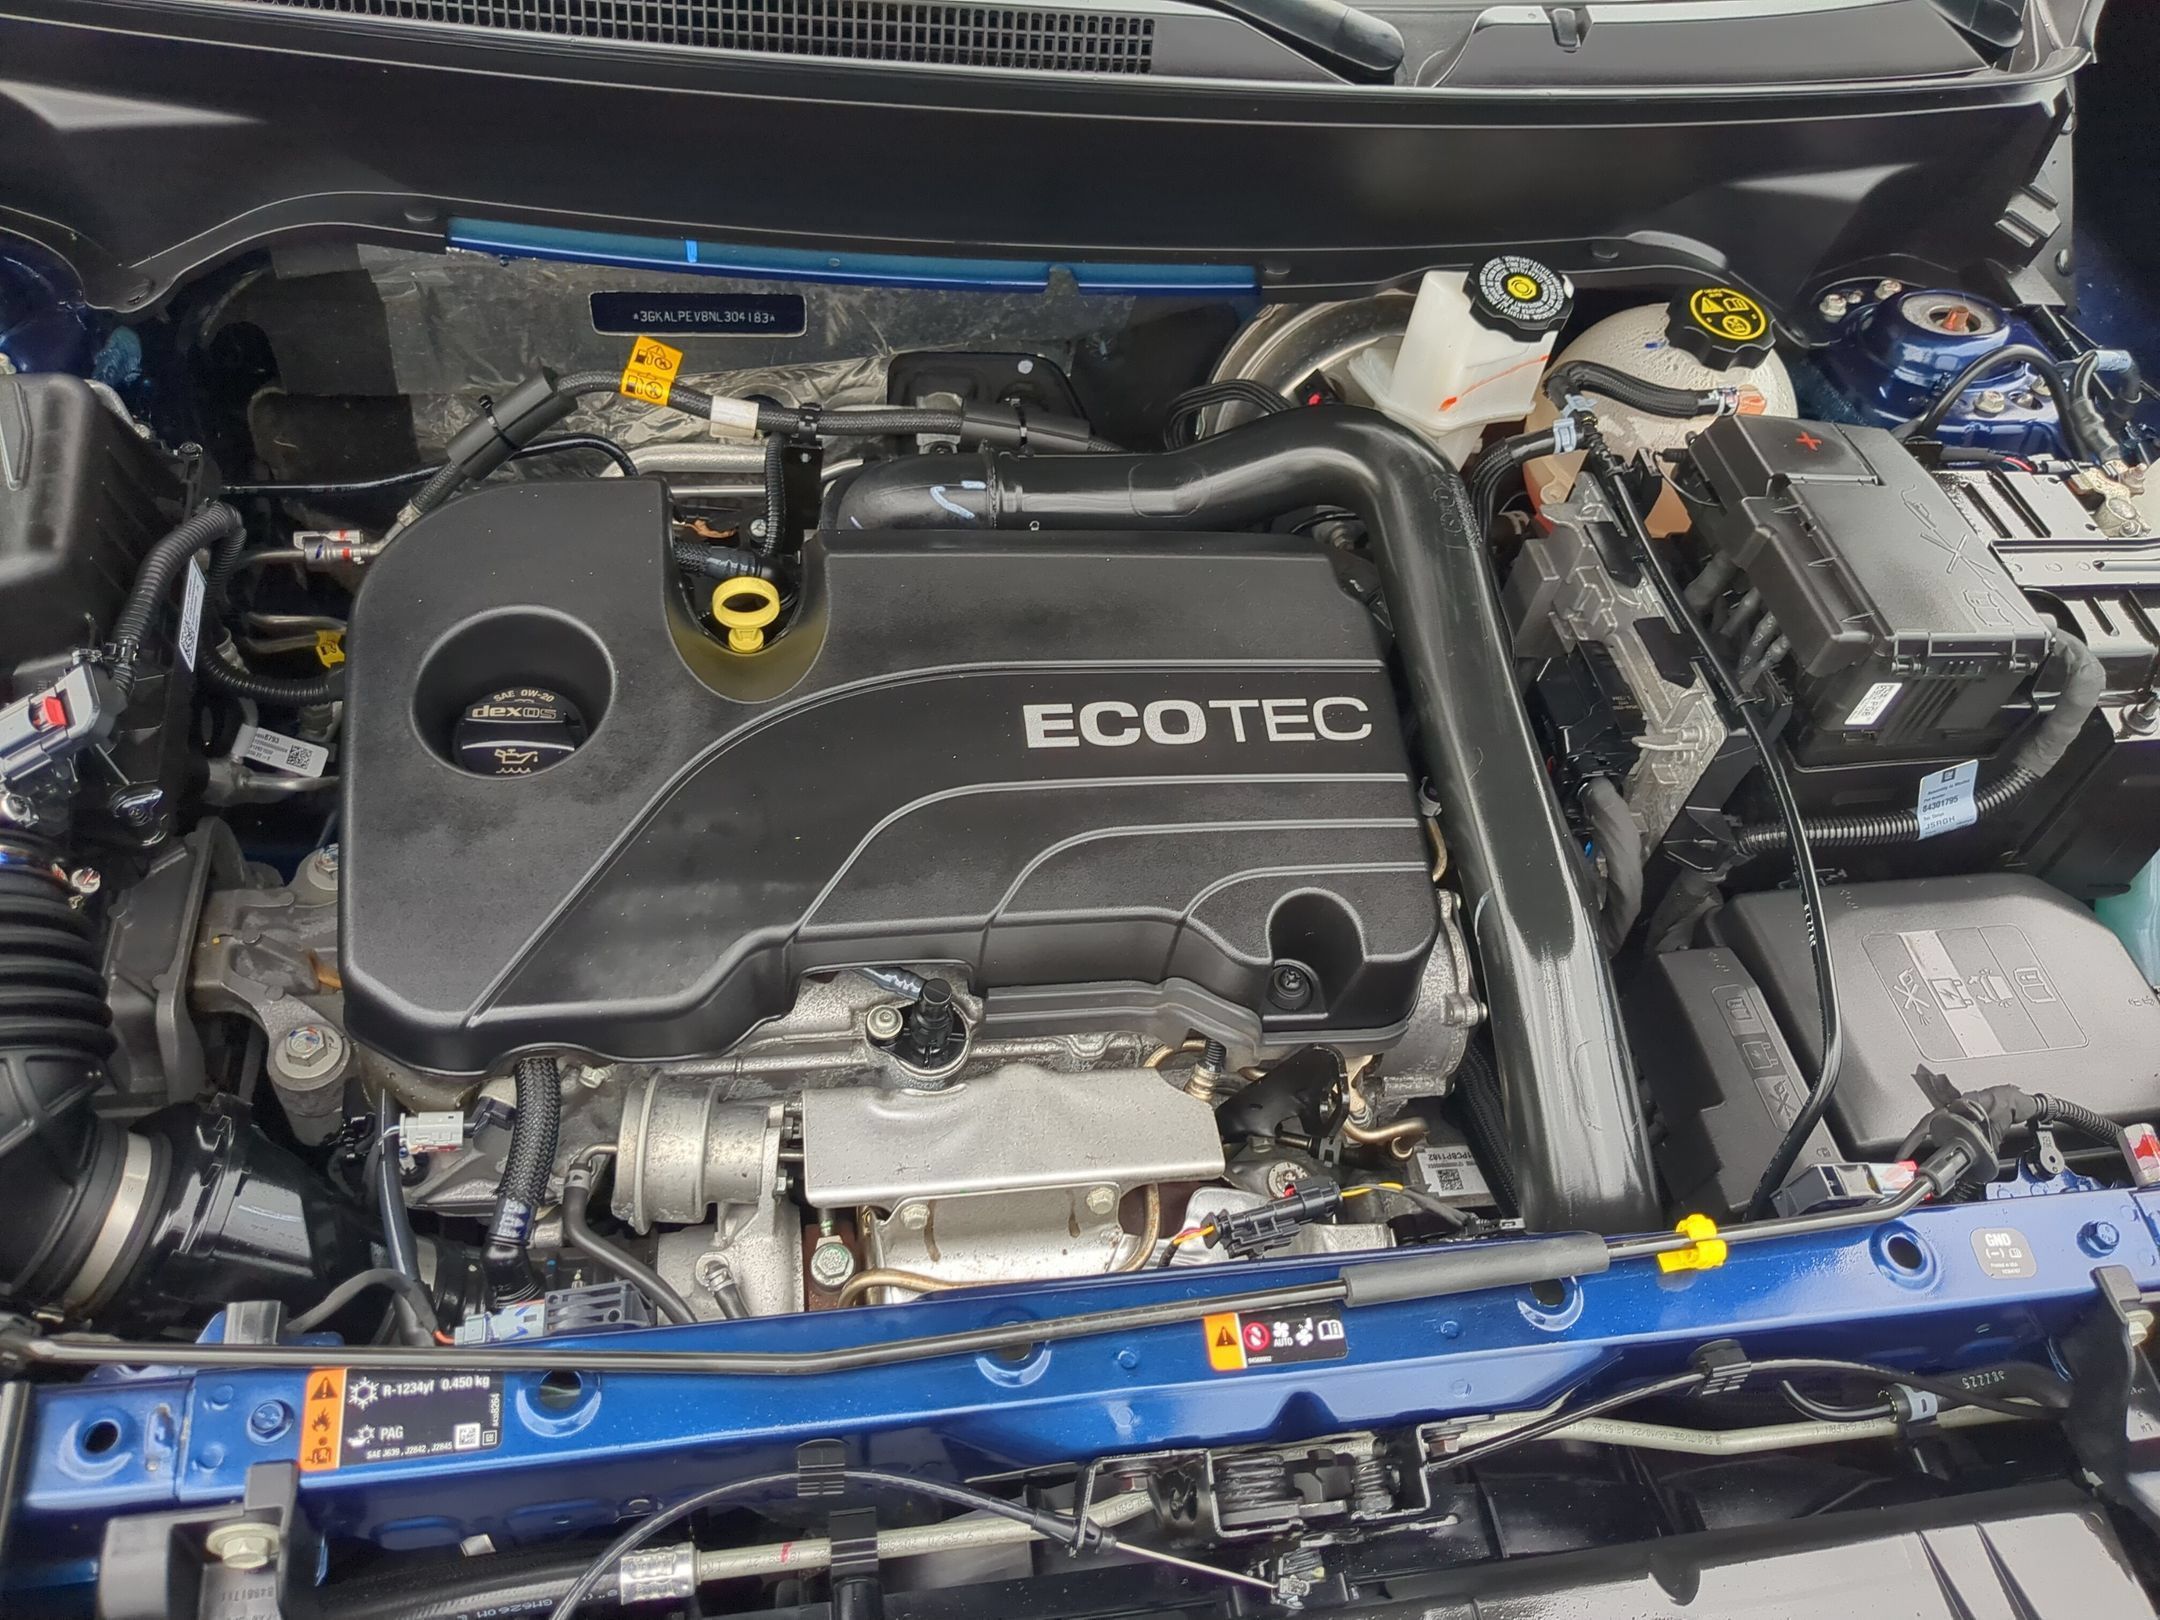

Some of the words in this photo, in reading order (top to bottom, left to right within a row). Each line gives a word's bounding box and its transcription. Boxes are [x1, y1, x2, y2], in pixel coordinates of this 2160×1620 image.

[493, 690, 515, 702] SAE
[520, 689, 555, 703] 0W-20
[472, 705, 557, 719] dexos
[1023, 697, 1373, 748] ECOTEC
[1985, 1232, 2012, 1247] GND
[1273, 1337, 1294, 1347] AUTO
[382, 1379, 435, 1397] R-1234yf
[441, 1376, 473, 1391] 0.450
[475, 1375, 490, 1389] kg
[380, 1426, 404, 1441] PAG
